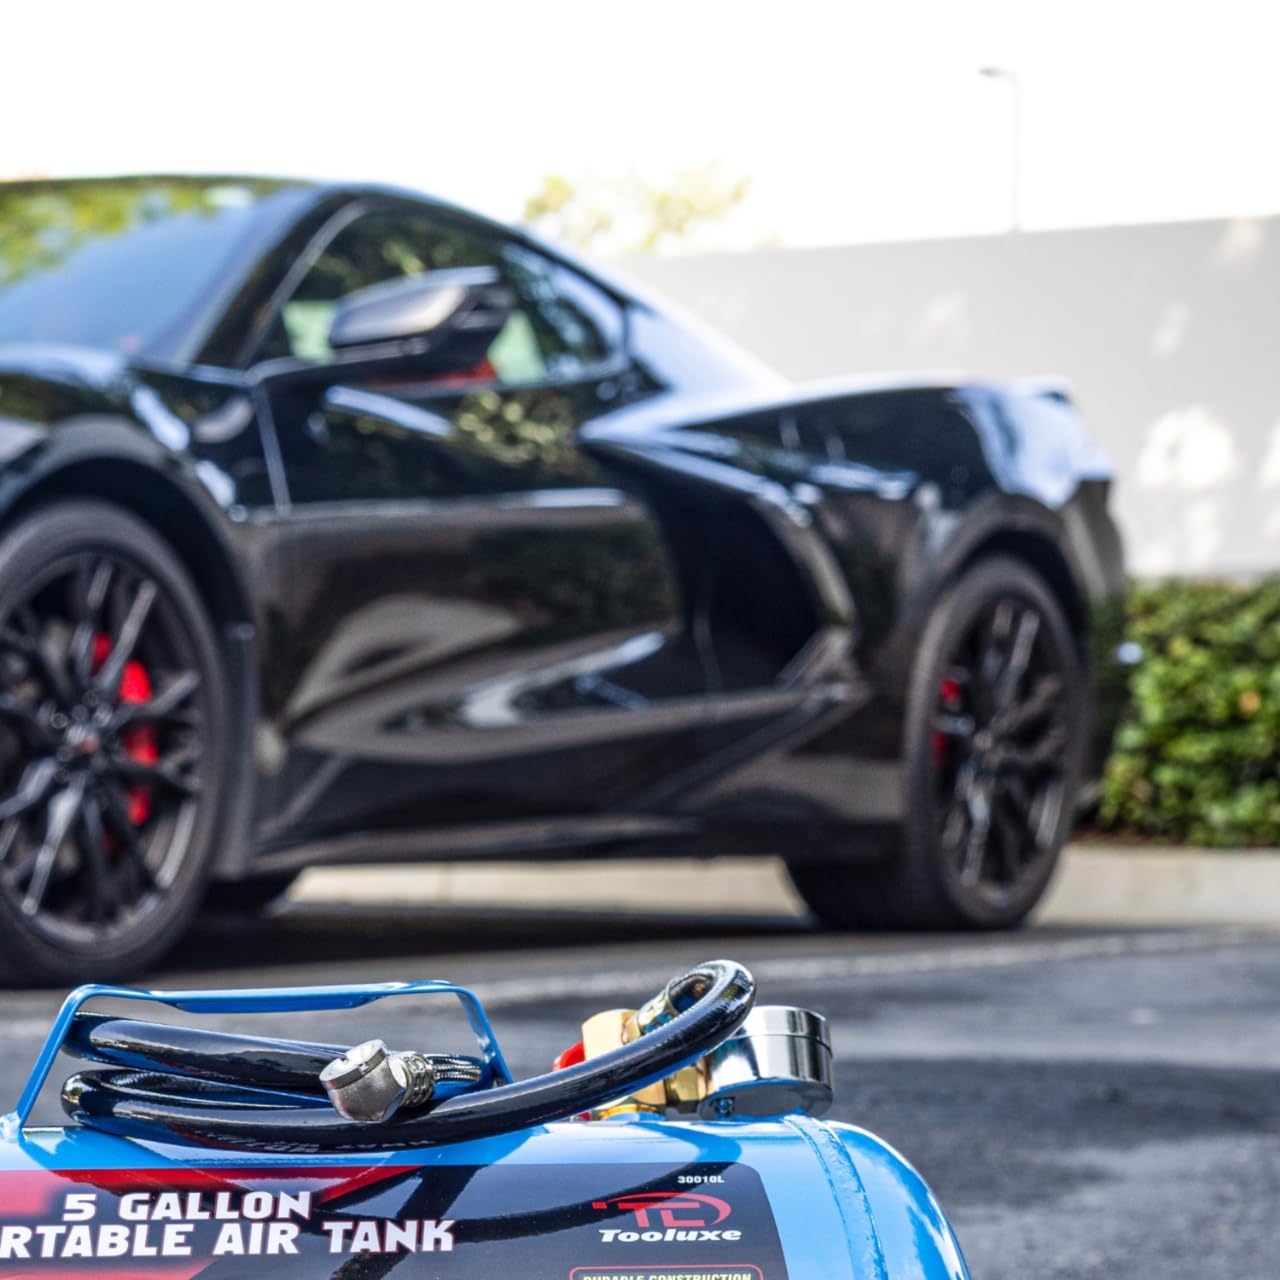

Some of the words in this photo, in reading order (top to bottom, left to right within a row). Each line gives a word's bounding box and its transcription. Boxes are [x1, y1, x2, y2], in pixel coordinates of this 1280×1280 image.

[677, 1175, 725, 1184] 30010L
[63, 1193, 97, 1221] 5
[119, 1191, 311, 1220] GALLON
[213, 1221, 300, 1255] AIR
[324, 1219, 454, 1253] TANK
[599, 1228, 743, 1242] Tooluxe
